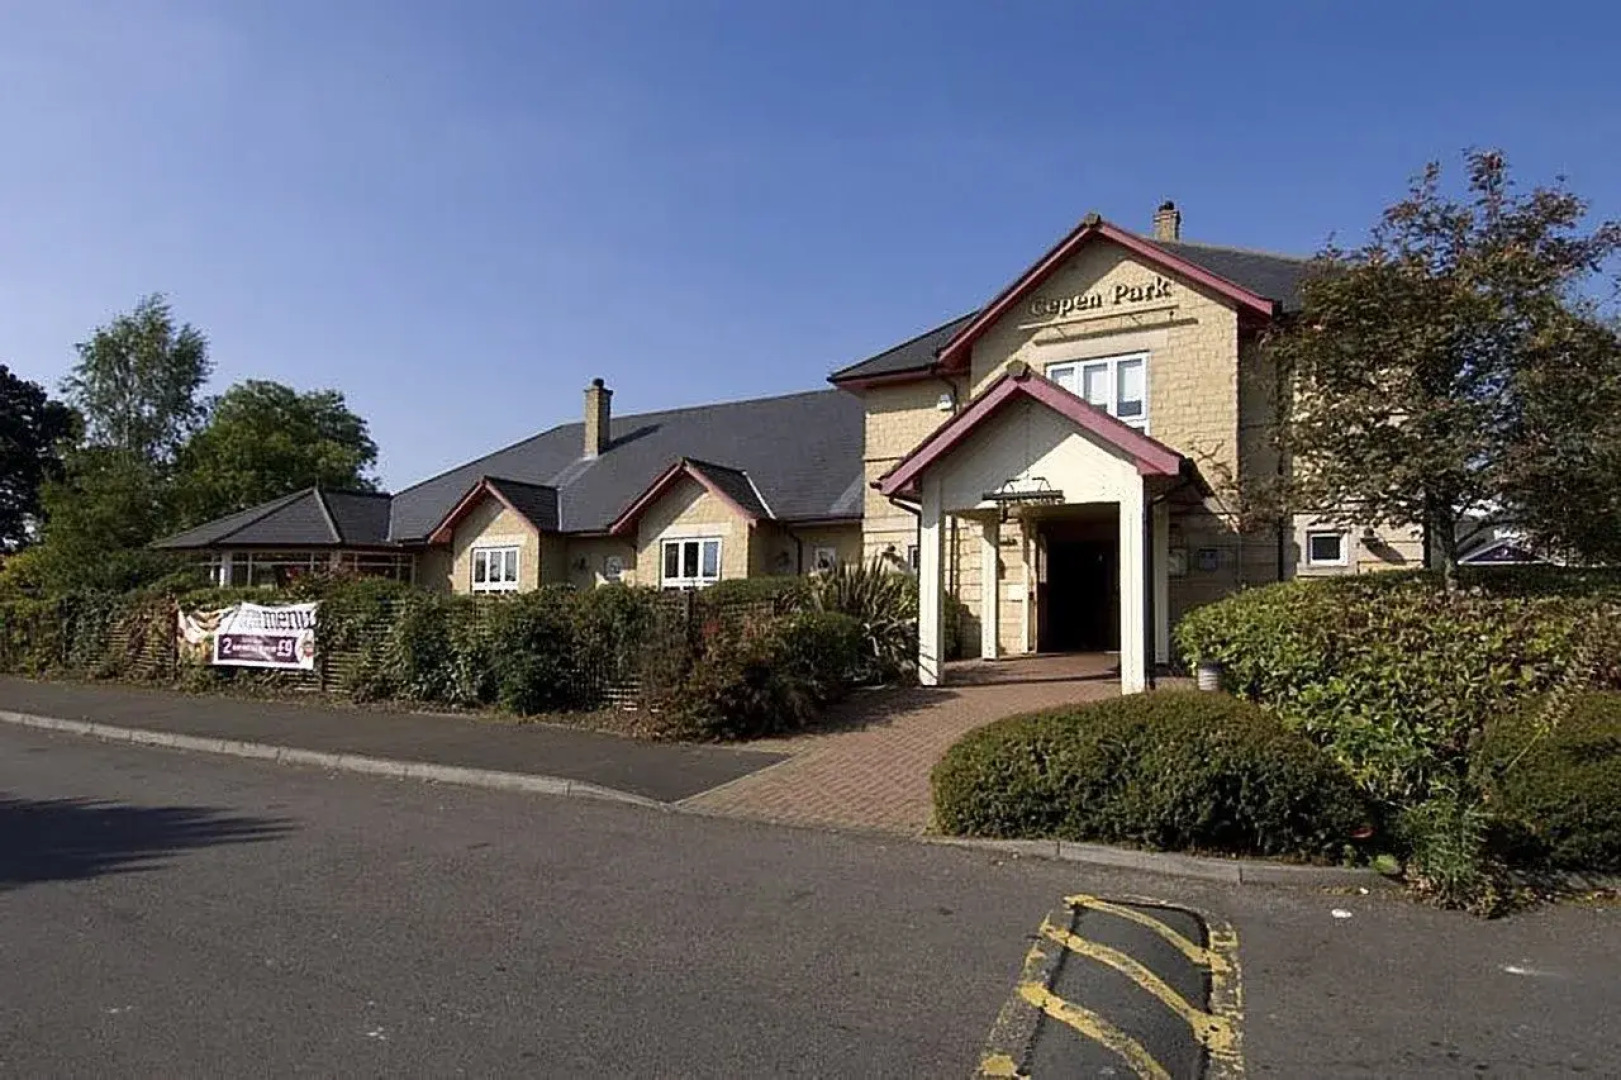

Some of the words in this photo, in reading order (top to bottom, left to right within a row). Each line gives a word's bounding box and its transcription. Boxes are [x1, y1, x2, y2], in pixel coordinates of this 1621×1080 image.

[1032, 293, 1103, 317] Cepen
[1113, 276, 1173, 304] Park
[262, 611, 312, 629] menu
[222, 637, 232, 653] 2
[276, 639, 292, 656] £9
